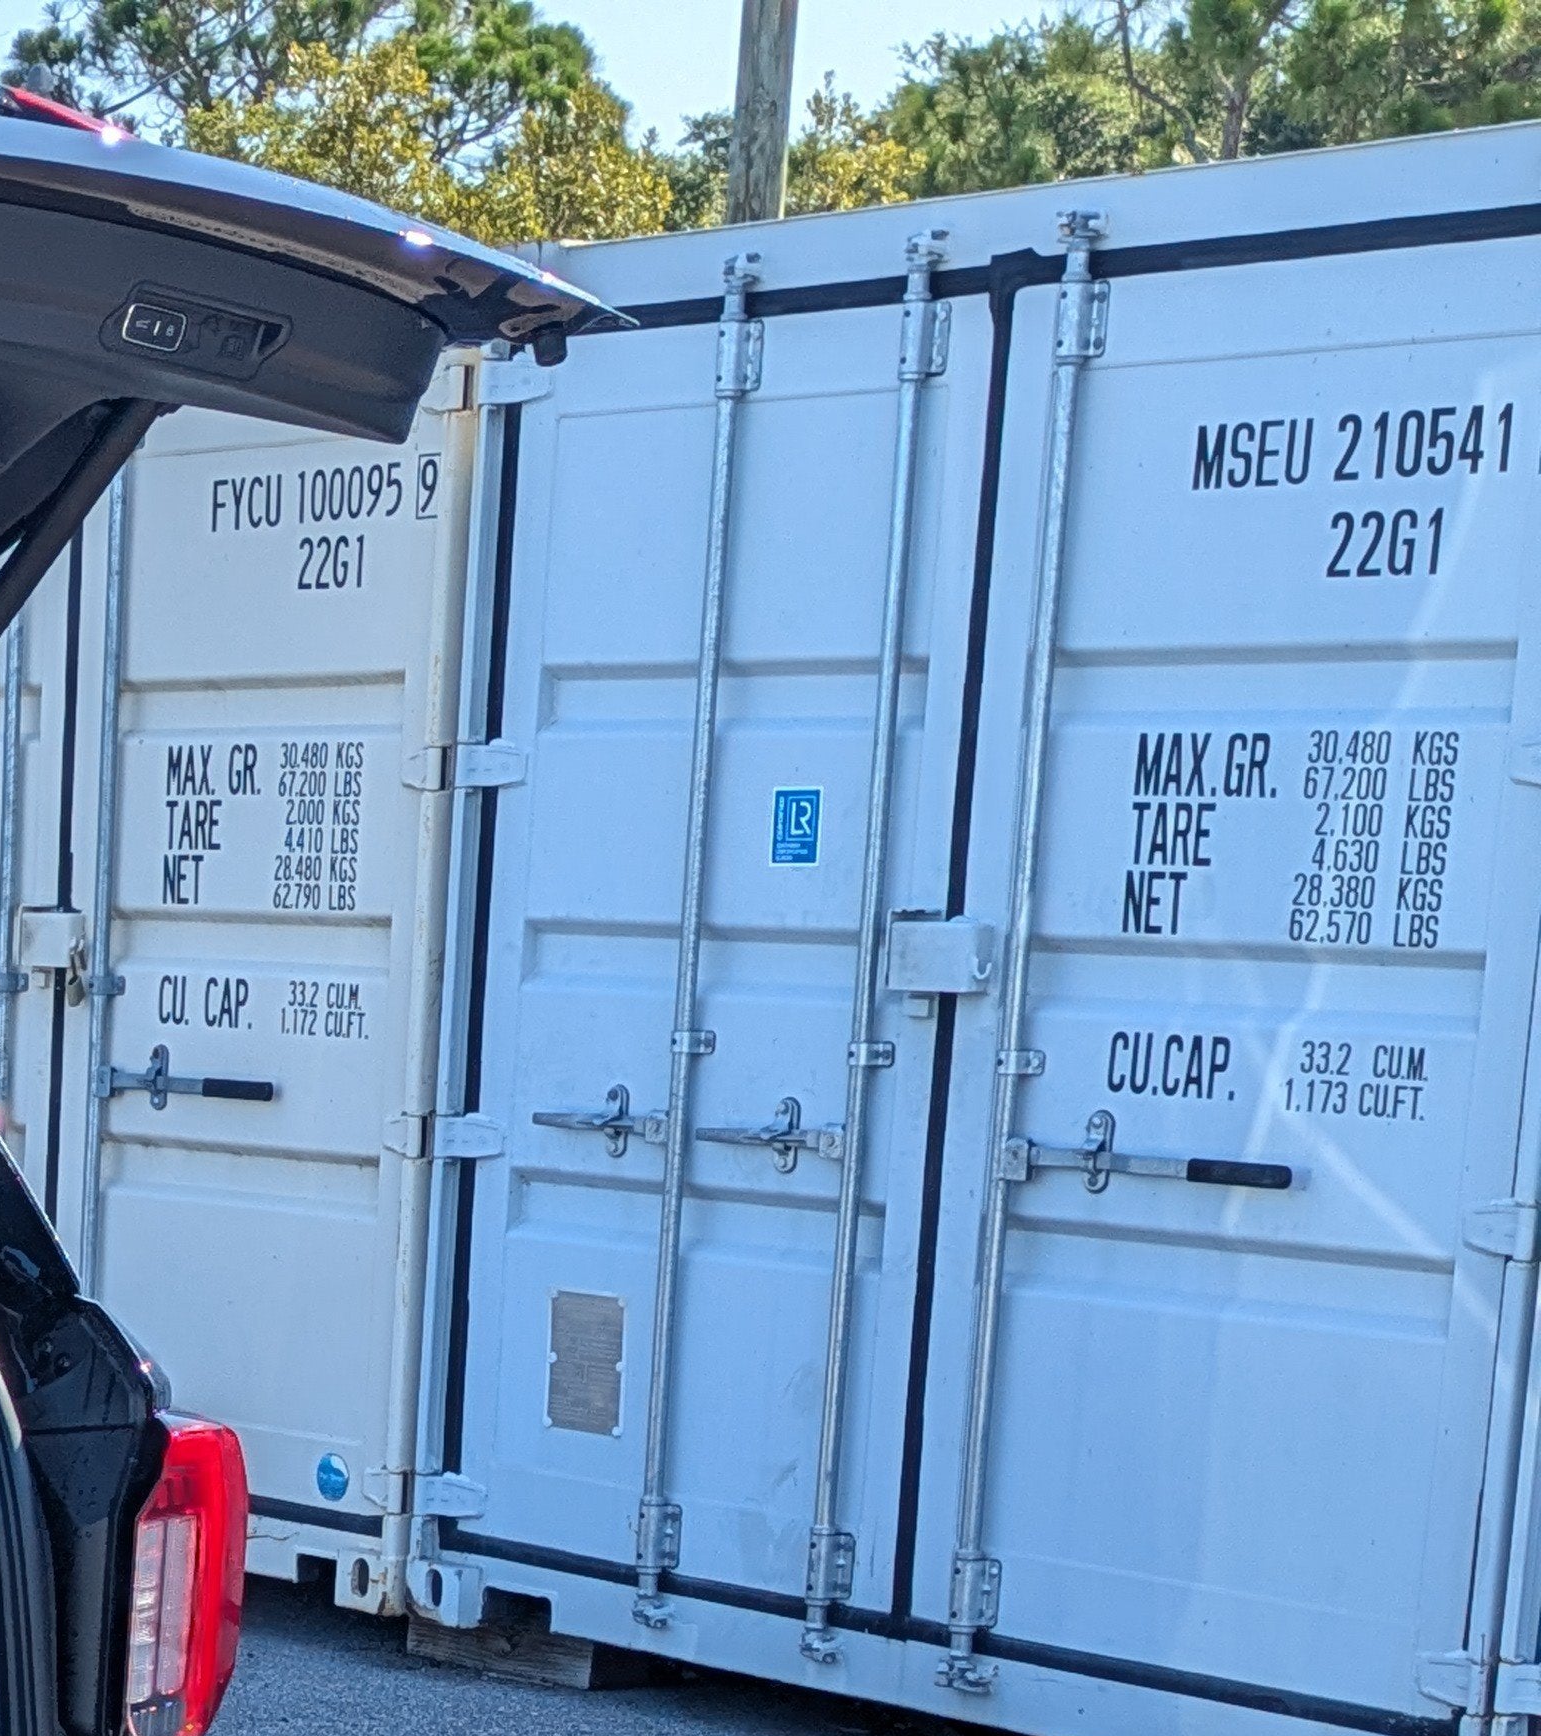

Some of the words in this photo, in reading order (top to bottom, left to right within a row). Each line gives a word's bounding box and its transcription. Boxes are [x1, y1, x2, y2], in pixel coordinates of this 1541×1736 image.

[1191, 417, 1314, 491] MSEU
[1333, 402, 1514, 482] 210541
[212, 473, 282, 533] FYCU
[298, 462, 403, 524] 100095
[420, 458, 438, 513] 9
[1325, 507, 1444, 578] 22G1
[297, 534, 365, 590] 22G1
[280, 742, 329, 769] 30.480
[335, 741, 365, 769] KGS
[1412, 730, 1460, 766] KGS
[166, 744, 216, 796] MAX.
[228, 743, 261, 795] GR.
[278, 771, 327, 797] 67.200
[334, 771, 363, 798] LBS
[1408, 768, 1455, 803] LBS
[165, 800, 222, 850] TARE
[285, 799, 325, 826] 2.000
[332, 799, 360, 826] KGS
[790, 800, 812, 836] LR
[1403, 804, 1452, 840] KGS
[284, 827, 324, 854] 4.410
[331, 828, 359, 855] LBS
[1132, 802, 1217, 867] TARE
[274, 855, 322, 882] 28.480
[329, 856, 358, 883] KGS
[1400, 841, 1447, 876] LBS
[162, 854, 204, 905] NET
[272, 883, 321, 910] 62.790
[328, 884, 356, 911] LBS
[1395, 877, 1444, 913] KGS
[1122, 870, 1188, 935] NET
[1392, 913, 1439, 949] LBS
[158, 975, 189, 1026] CU.
[204, 976, 253, 1030] CAP.
[287, 980, 320, 1008] 33.2
[326, 982, 363, 1011] CU.M.
[280, 1008, 318, 1036] 1.172
[324, 1010, 369, 1040] CU.FT.
[1299, 1040, 1353, 1077] 33.2
[1372, 1044, 1429, 1082] CU.M.
[1358, 1083, 1425, 1121] CU.FT.
